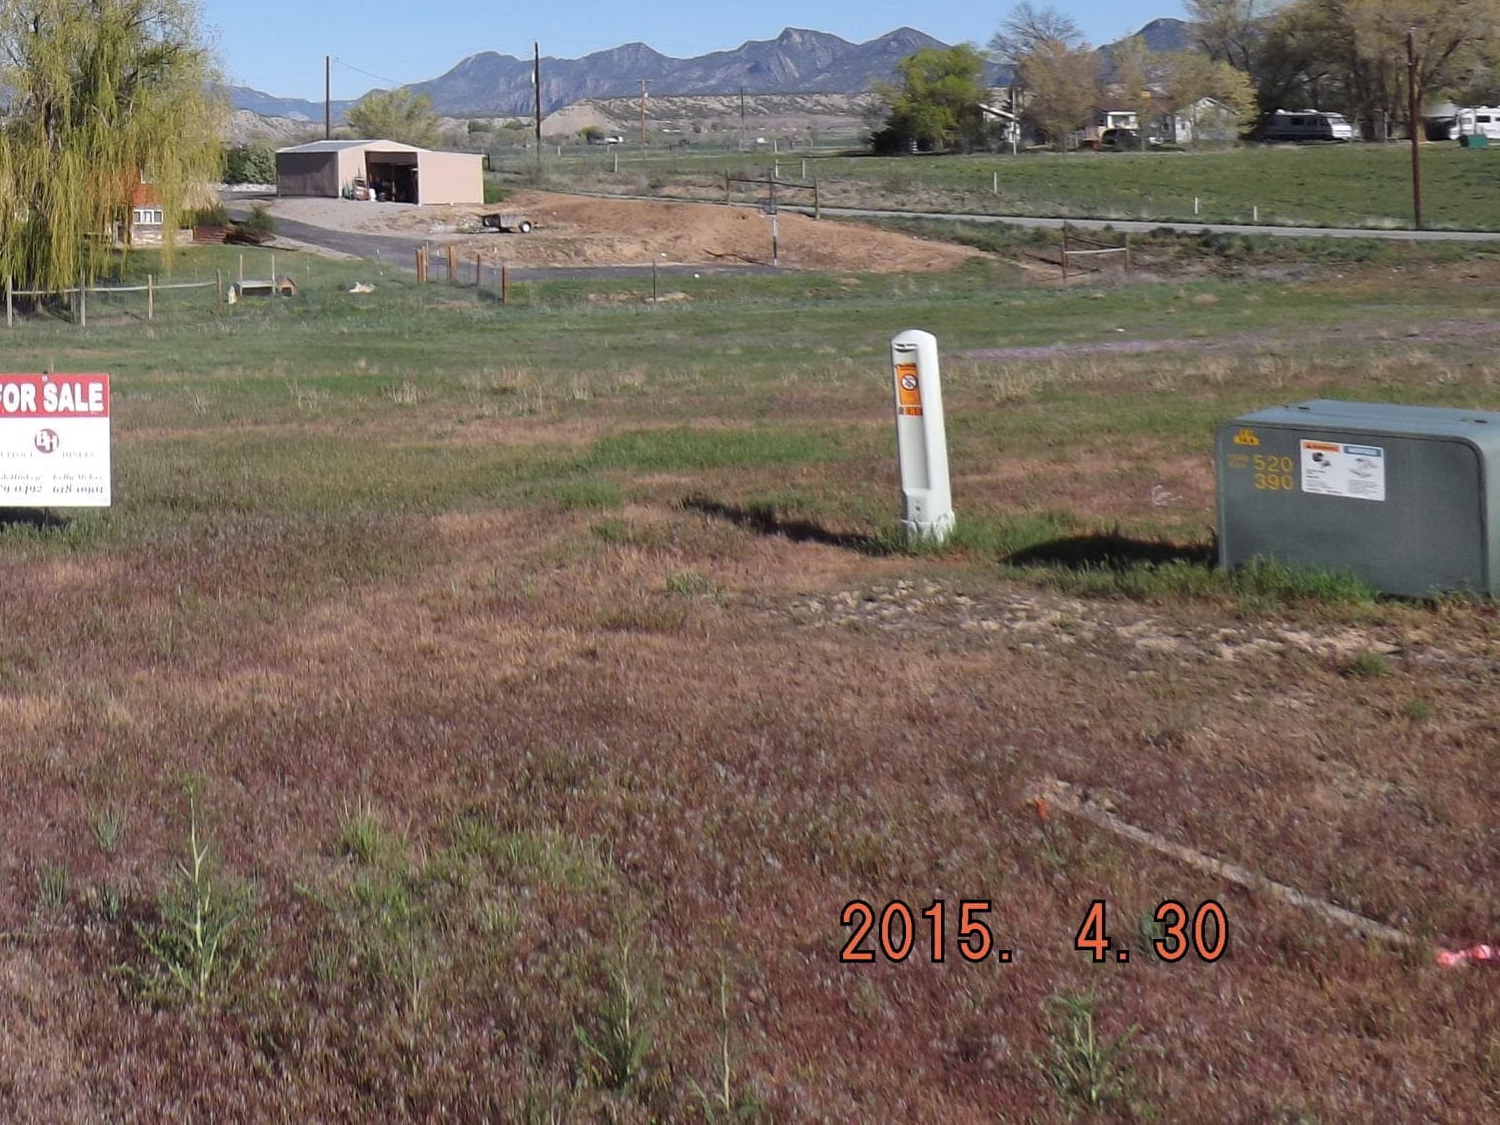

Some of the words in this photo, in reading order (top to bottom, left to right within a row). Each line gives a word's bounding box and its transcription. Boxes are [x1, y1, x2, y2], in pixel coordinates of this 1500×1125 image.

[43, 383, 104, 412] SALE
[1253, 455, 1293, 472] 520
[1254, 473, 1294, 490] 390
